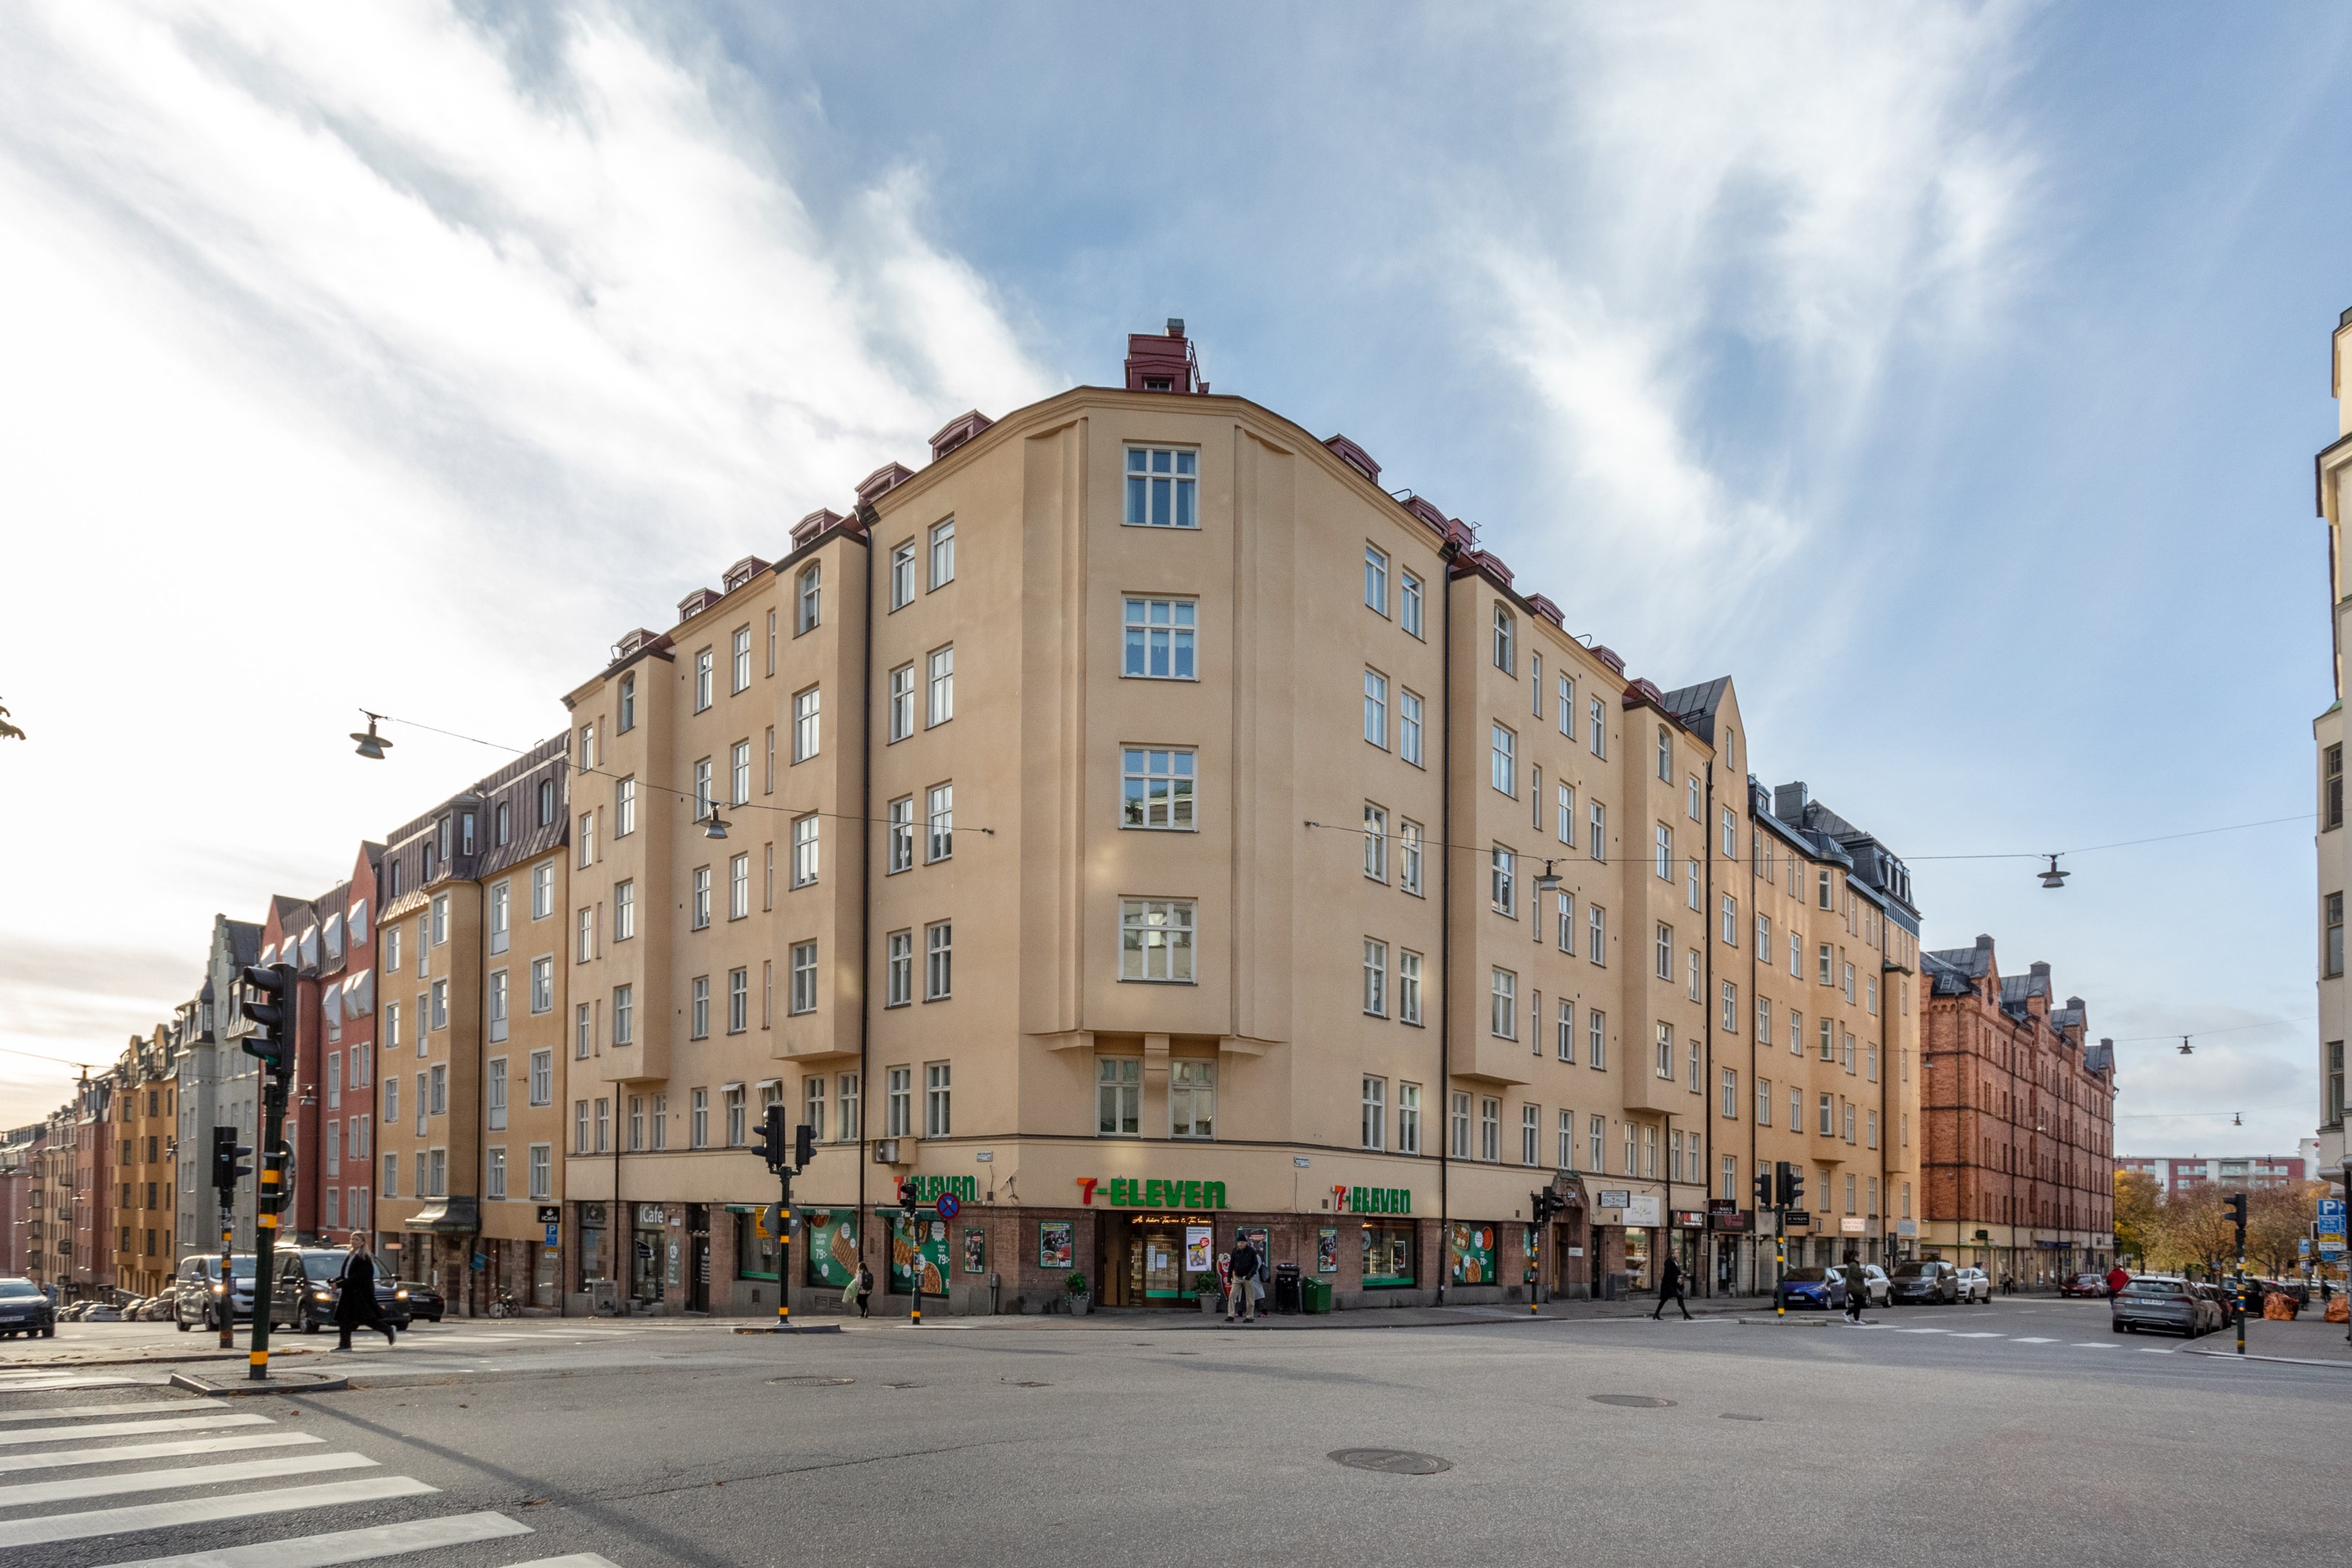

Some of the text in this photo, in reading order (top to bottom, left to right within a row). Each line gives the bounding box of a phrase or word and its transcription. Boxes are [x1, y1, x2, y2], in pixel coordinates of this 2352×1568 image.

[640, 1205, 663, 1223] iCafe
[2323, 1201, 2336, 1214] P
[549, 1225, 556, 1234] P
